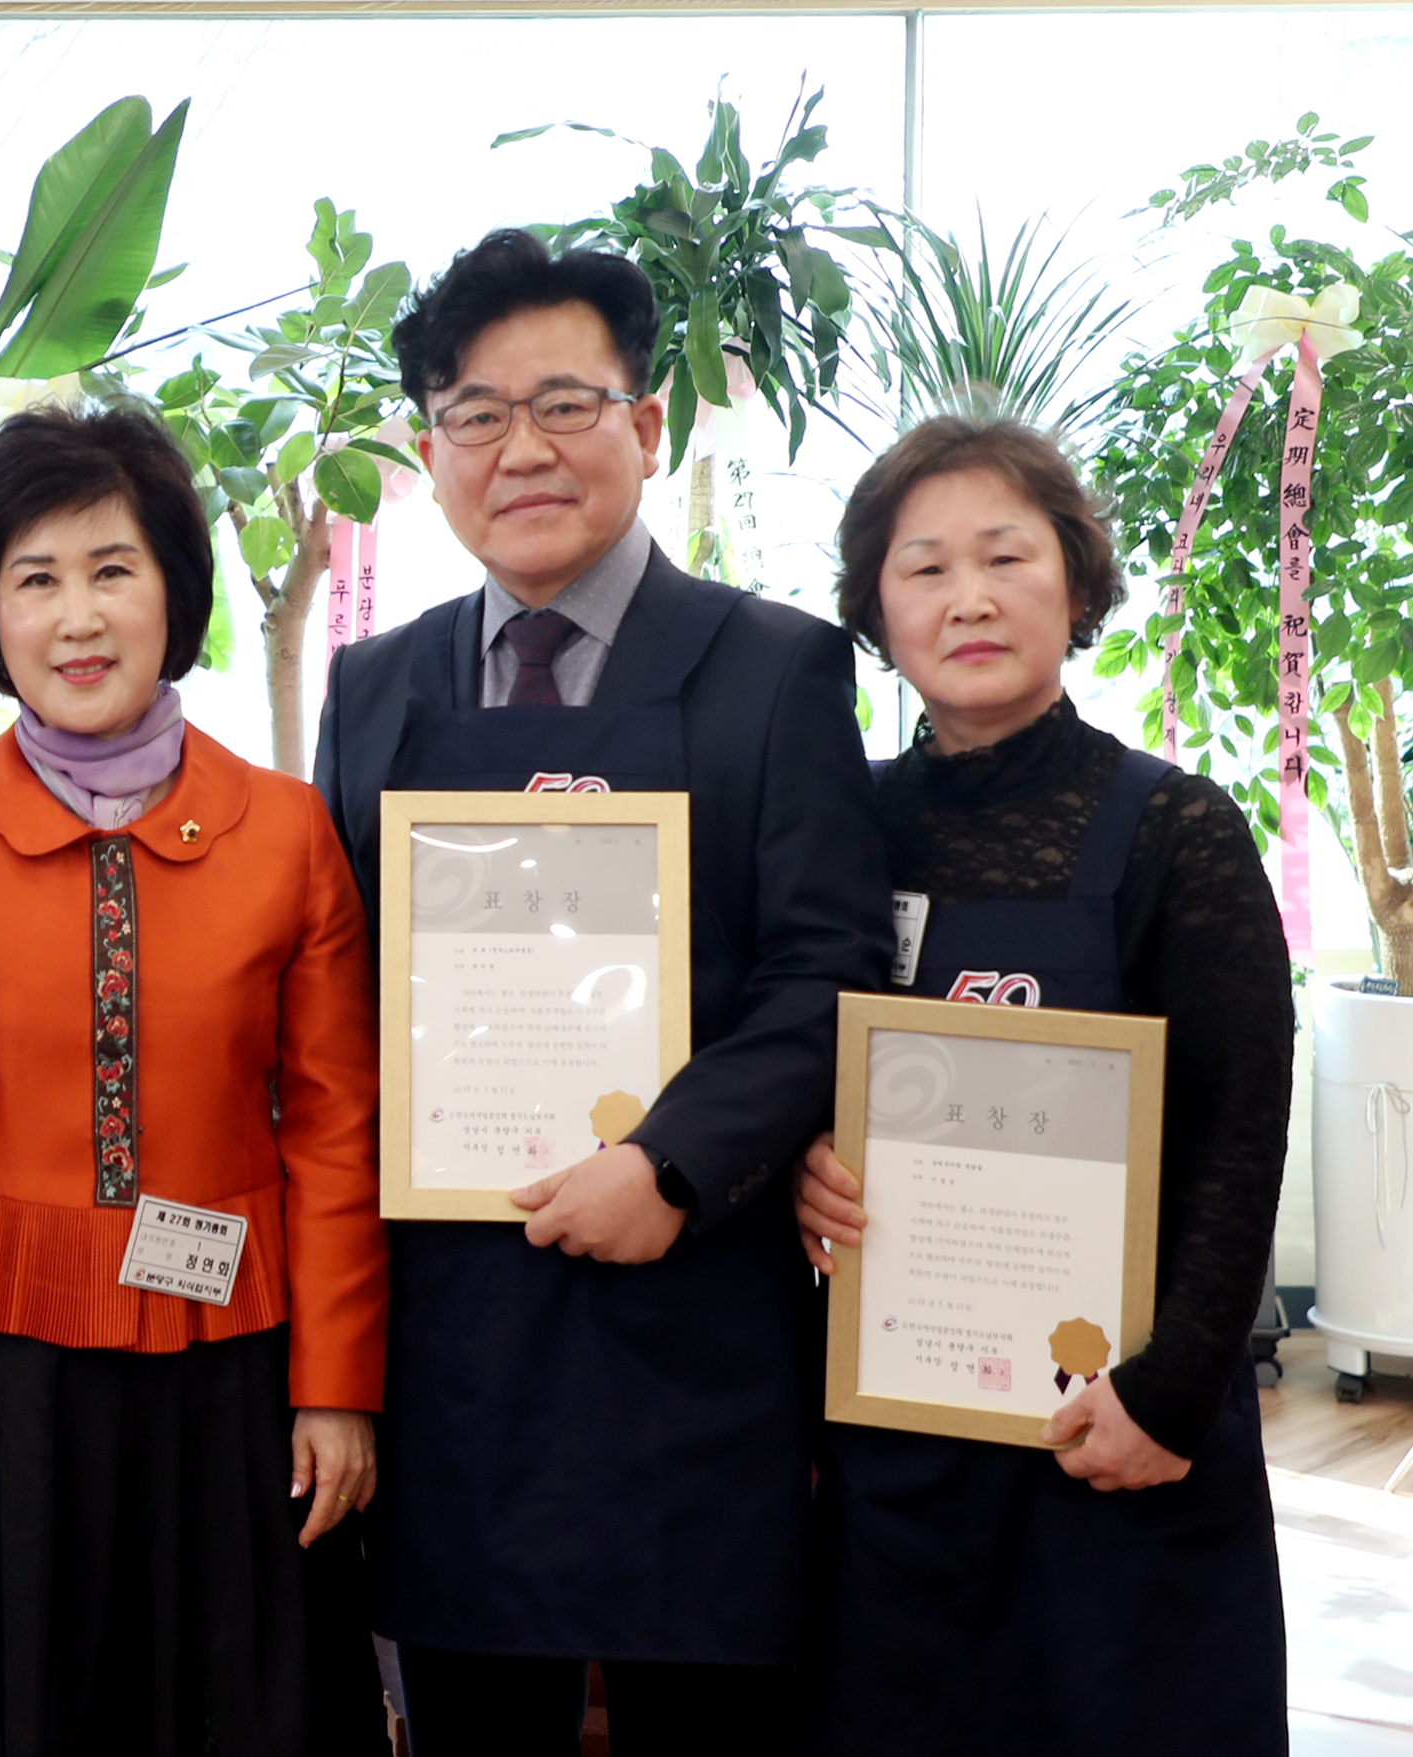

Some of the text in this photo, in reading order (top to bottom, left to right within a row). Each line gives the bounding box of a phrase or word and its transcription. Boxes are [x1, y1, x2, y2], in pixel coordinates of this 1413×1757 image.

[328, 579, 350, 656] 푸른
[484, 890, 582, 914] 표창장
[945, 1104, 1049, 1135] 표창장
[156, 1210, 228, 1237] 제 27회 정기총회
[185, 1253, 230, 1277] 정연화
[145, 1271, 222, 1296] 분당구 외식업지부
